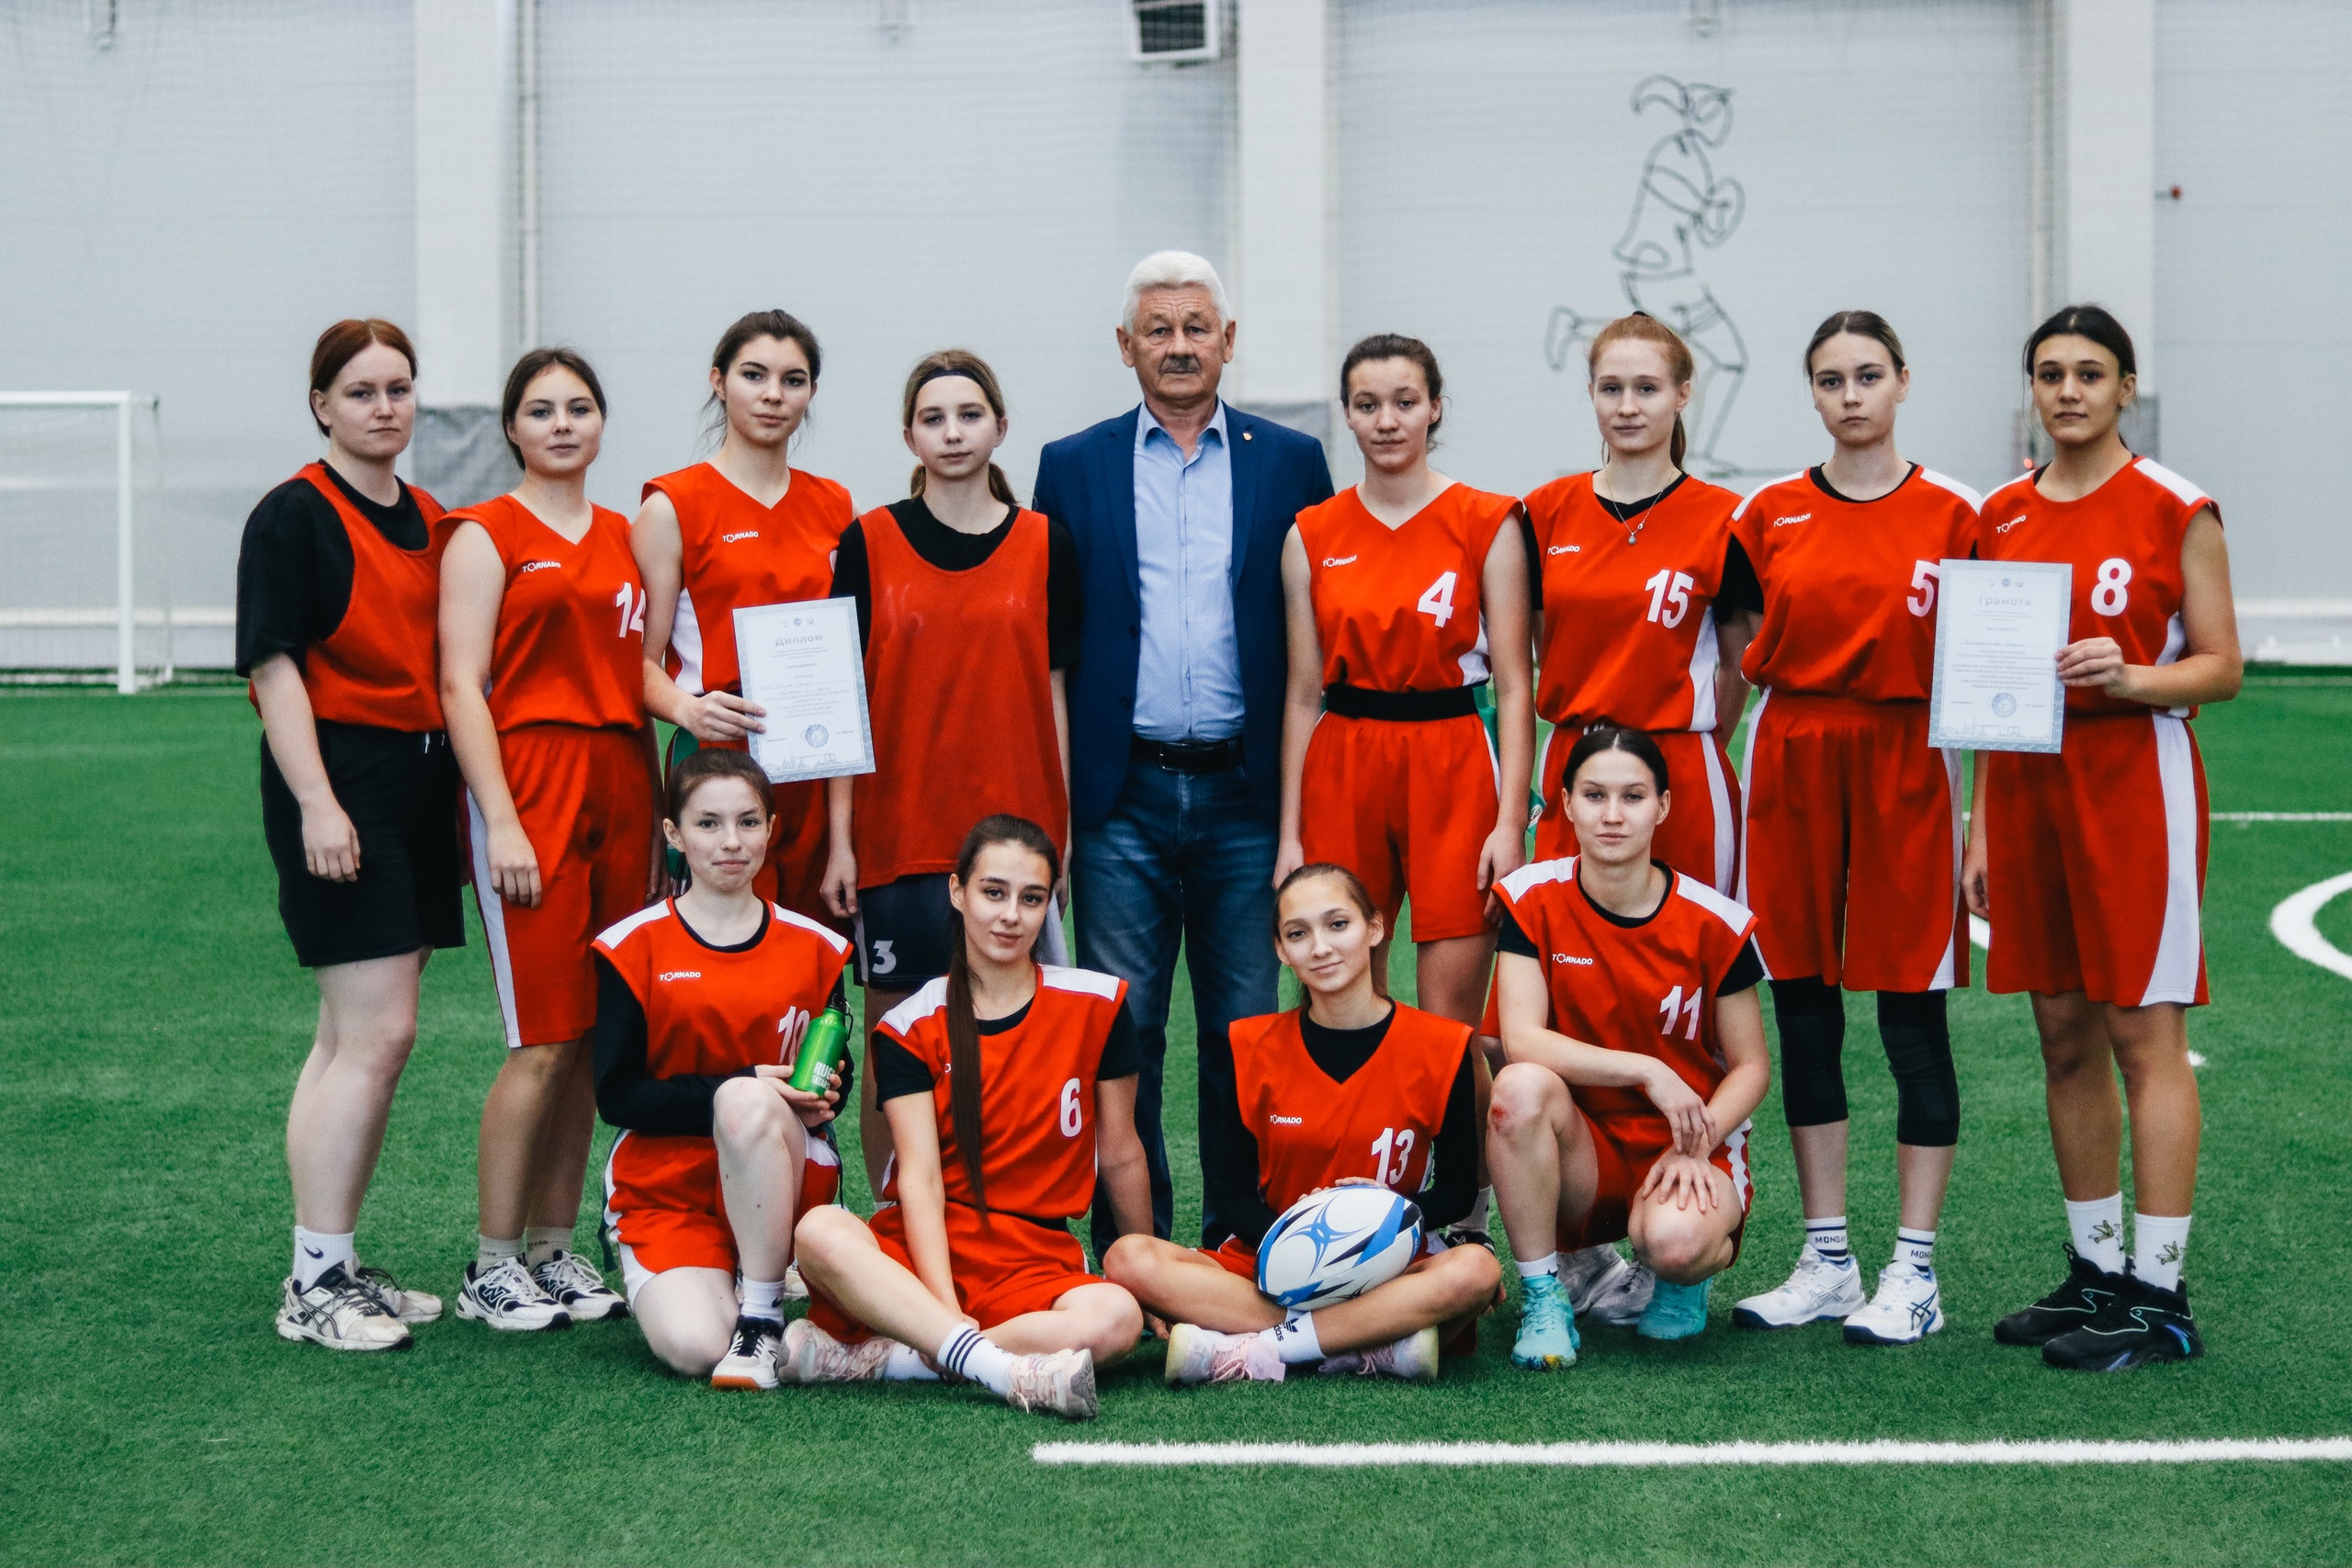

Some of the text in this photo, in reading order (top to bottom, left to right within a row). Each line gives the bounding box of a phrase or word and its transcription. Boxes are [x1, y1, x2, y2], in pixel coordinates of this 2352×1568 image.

[1773, 513, 1812, 527] TORNADO
[722, 530, 759, 543] TORNADO
[522, 560, 561, 573] TORNADO
[1322, 554, 1358, 568] TORNADO
[1417, 570, 1457, 628] 4
[1645, 569, 1695, 629] 15
[1906, 559, 1939, 617] 5
[2090, 557, 2132, 616] 8
[616, 581, 647, 644] 14
[1979, 595, 2031, 607] Грамота
[775, 633, 823, 648] Диплом
[872, 940, 897, 974] 3
[1552, 953, 1594, 965] TORNADO
[659, 971, 701, 982] TORNADO
[1659, 985, 1702, 1040] 11
[777, 1005, 810, 1066] 10
[813, 1061, 835, 1079] RUG
[1059, 1077, 1082, 1137] 6
[1270, 1114, 1303, 1125] TORNADO
[1371, 1127, 1415, 1185] 13
